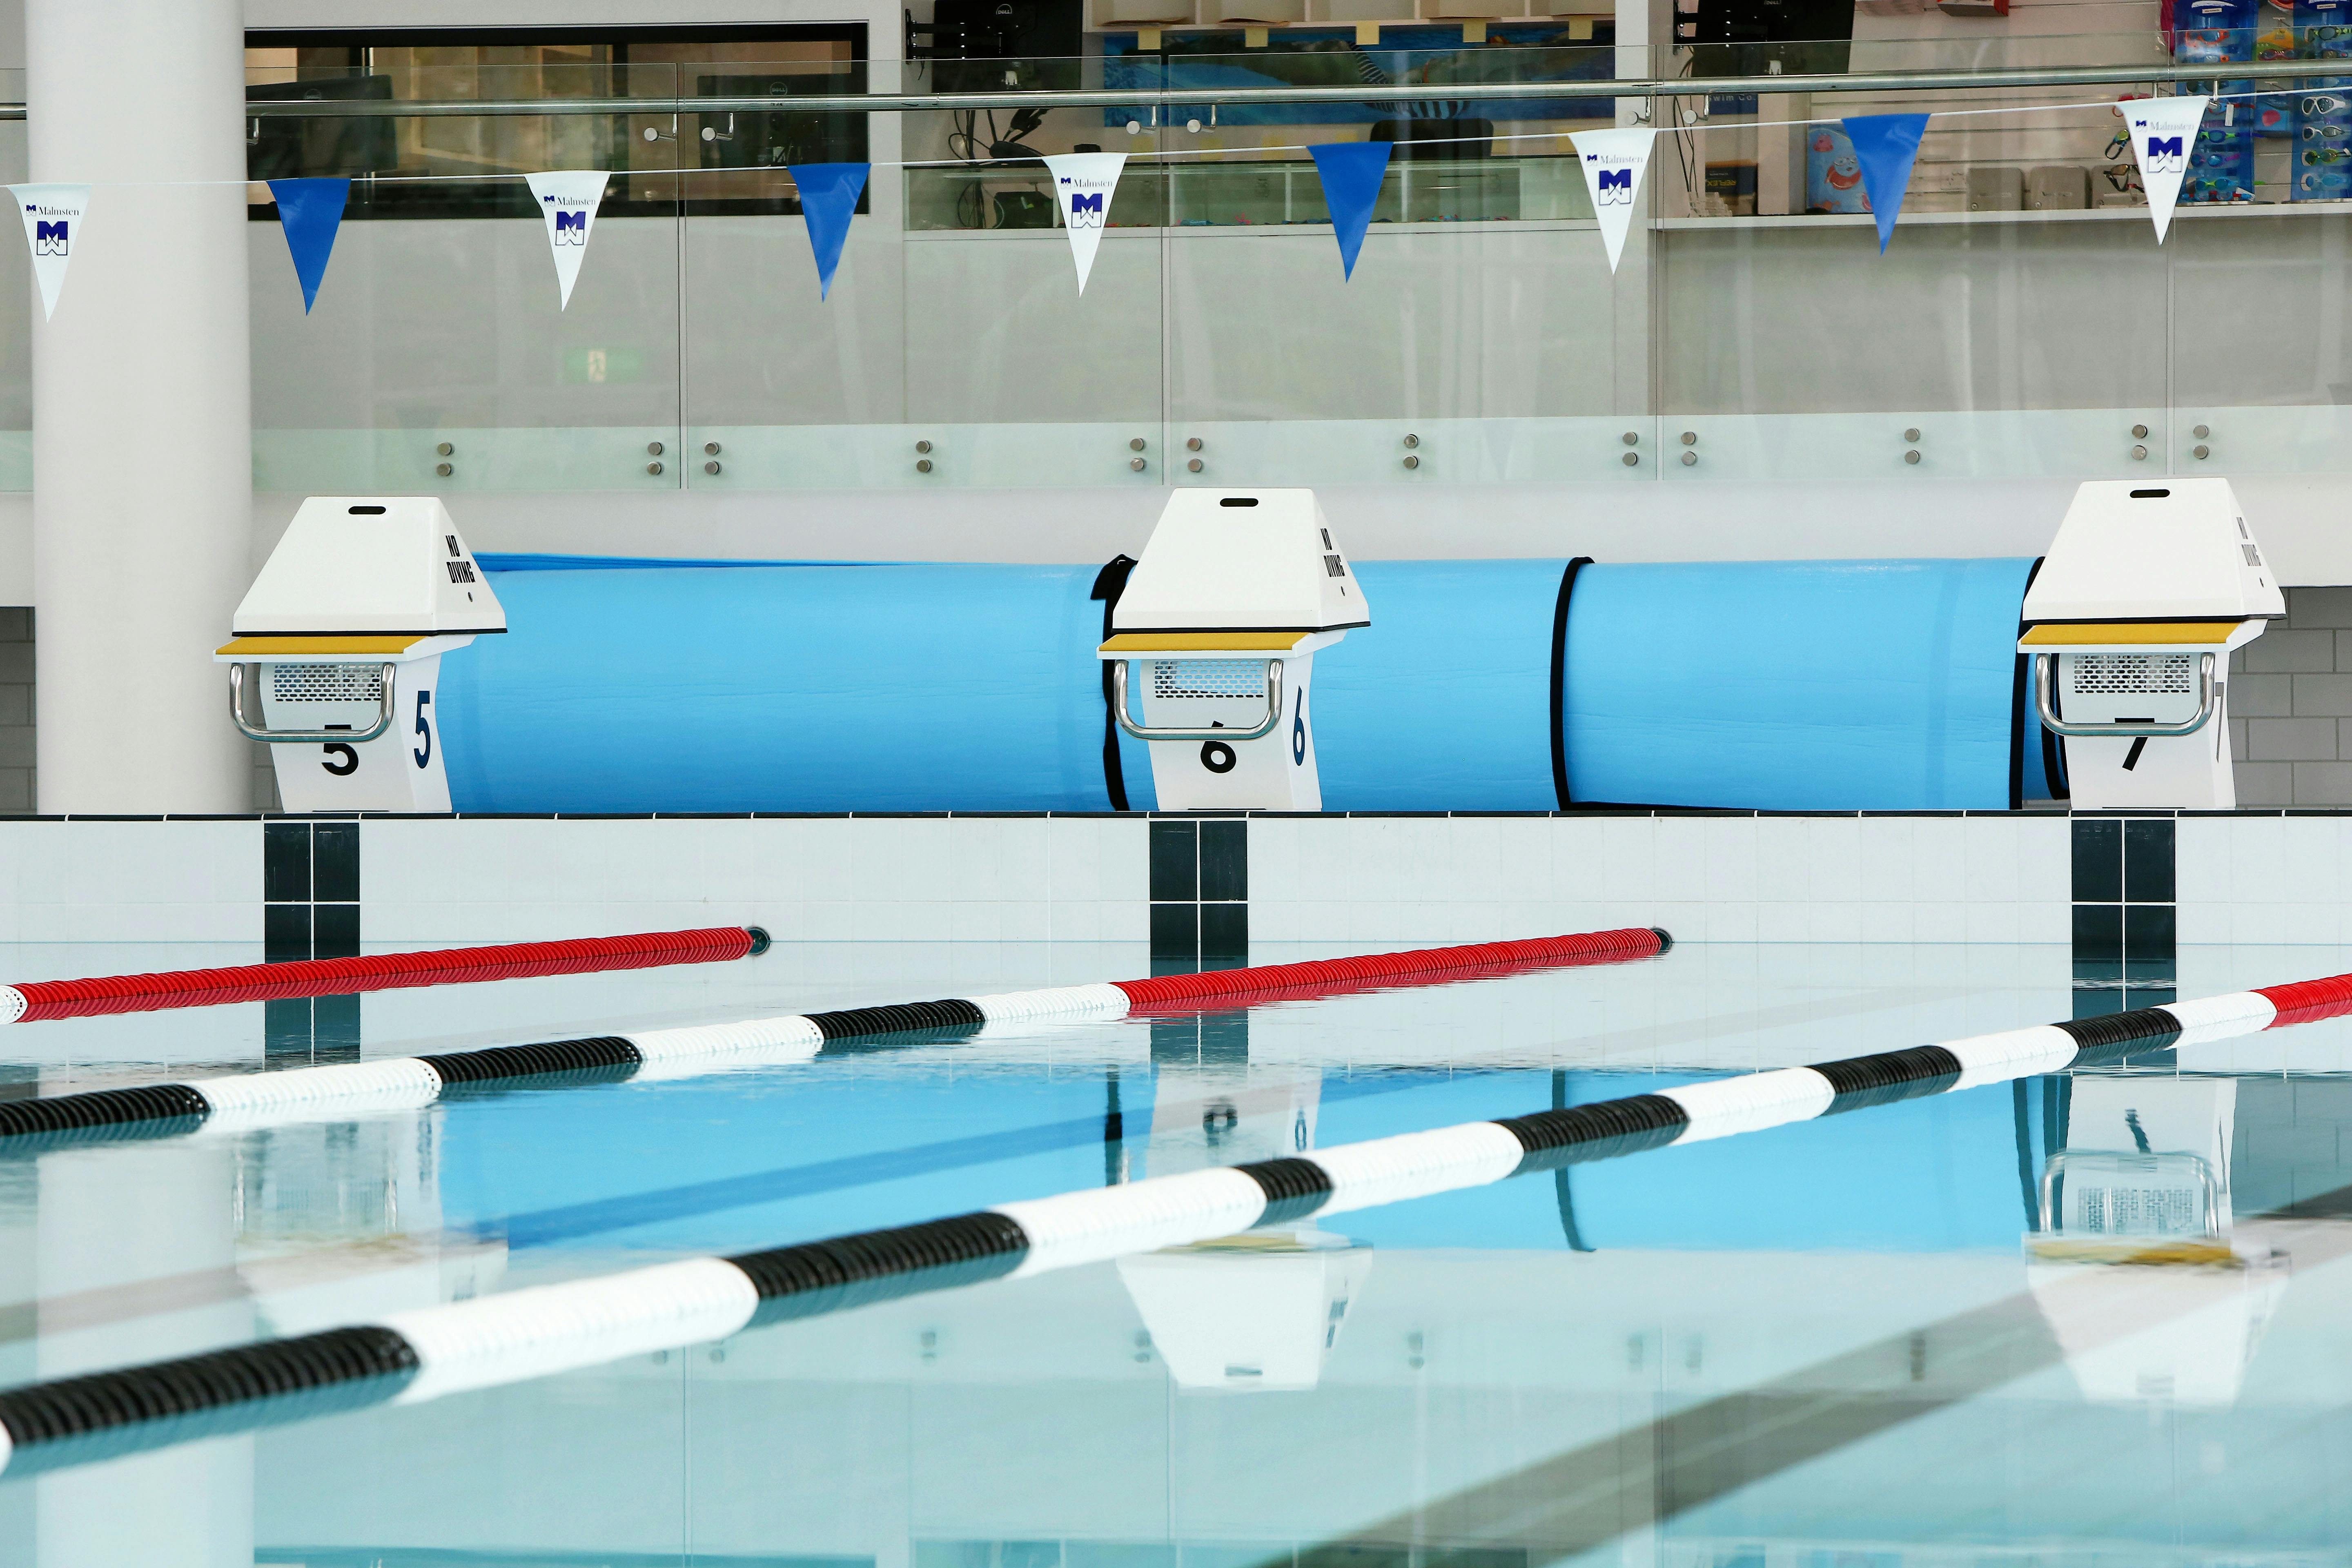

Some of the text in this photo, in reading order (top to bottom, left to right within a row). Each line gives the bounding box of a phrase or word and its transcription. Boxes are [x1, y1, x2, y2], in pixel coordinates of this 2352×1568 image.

[1601, 155, 1643, 164] Malmsten
[1074, 179, 1112, 188] Malmsten
[39, 206, 79, 216] Malmsten
[558, 196, 595, 206] Malmsten
[445, 535, 460, 557] NO
[1321, 528, 1332, 550] NO
[446, 561, 475, 583] DIVING
[1323, 555, 1345, 577] DIVING
[414, 690, 431, 769] 5
[1293, 685, 1305, 766] 6
[321, 724, 359, 776] 5
[1200, 720, 1237, 774] 6
[2115, 717, 2155, 771] 7
